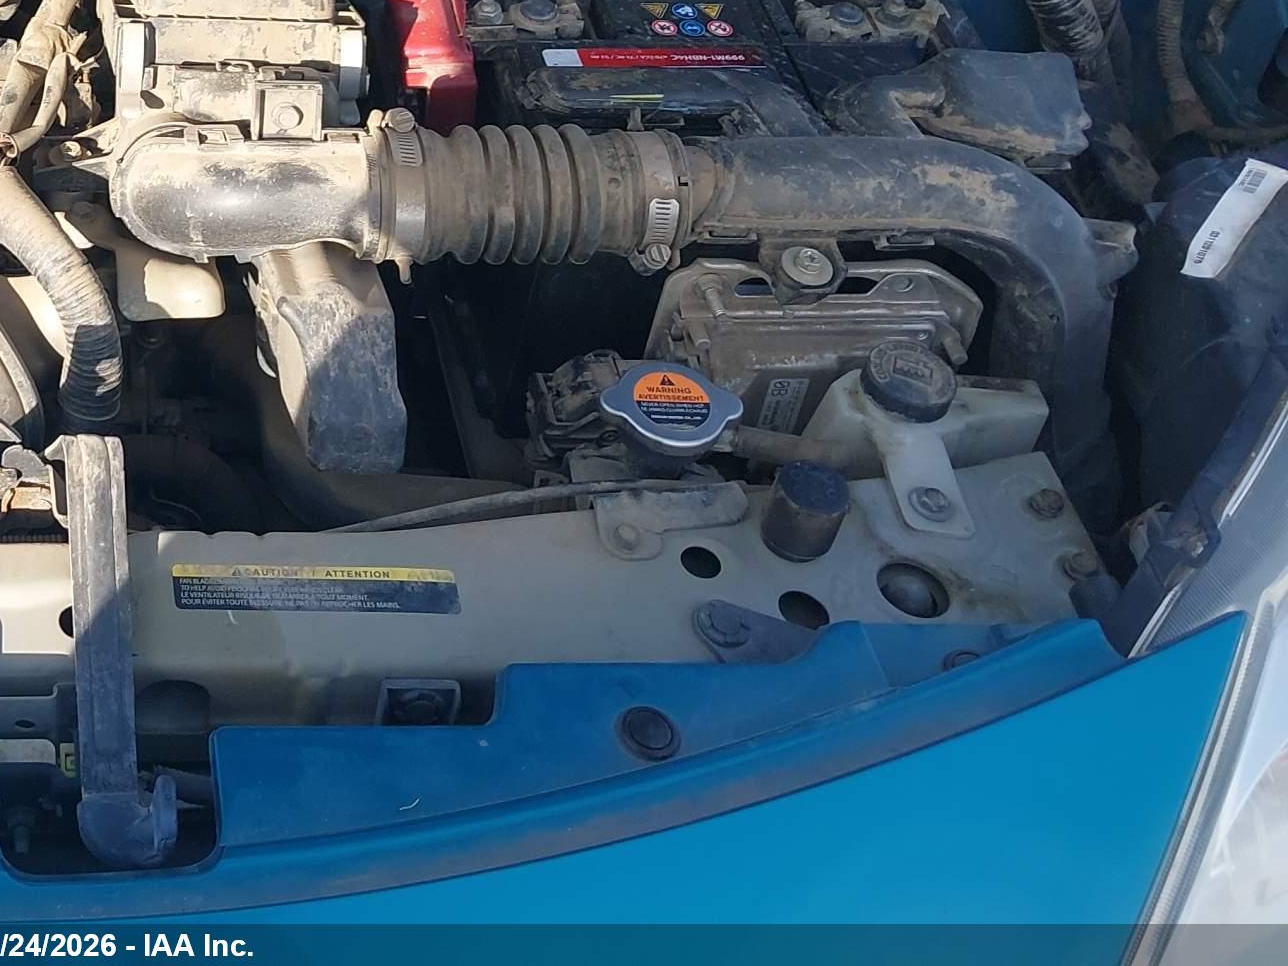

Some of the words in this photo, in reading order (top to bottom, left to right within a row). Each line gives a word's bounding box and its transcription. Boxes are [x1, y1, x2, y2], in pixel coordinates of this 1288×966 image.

[645, 386, 692, 395] WARNING
[638, 393, 704, 402] AVERTISSEMENT
[244, 569, 299, 577] CAUTION
[325, 570, 391, 579] ATTENTION
[189, 591, 234, 599] VENTILATEUR
